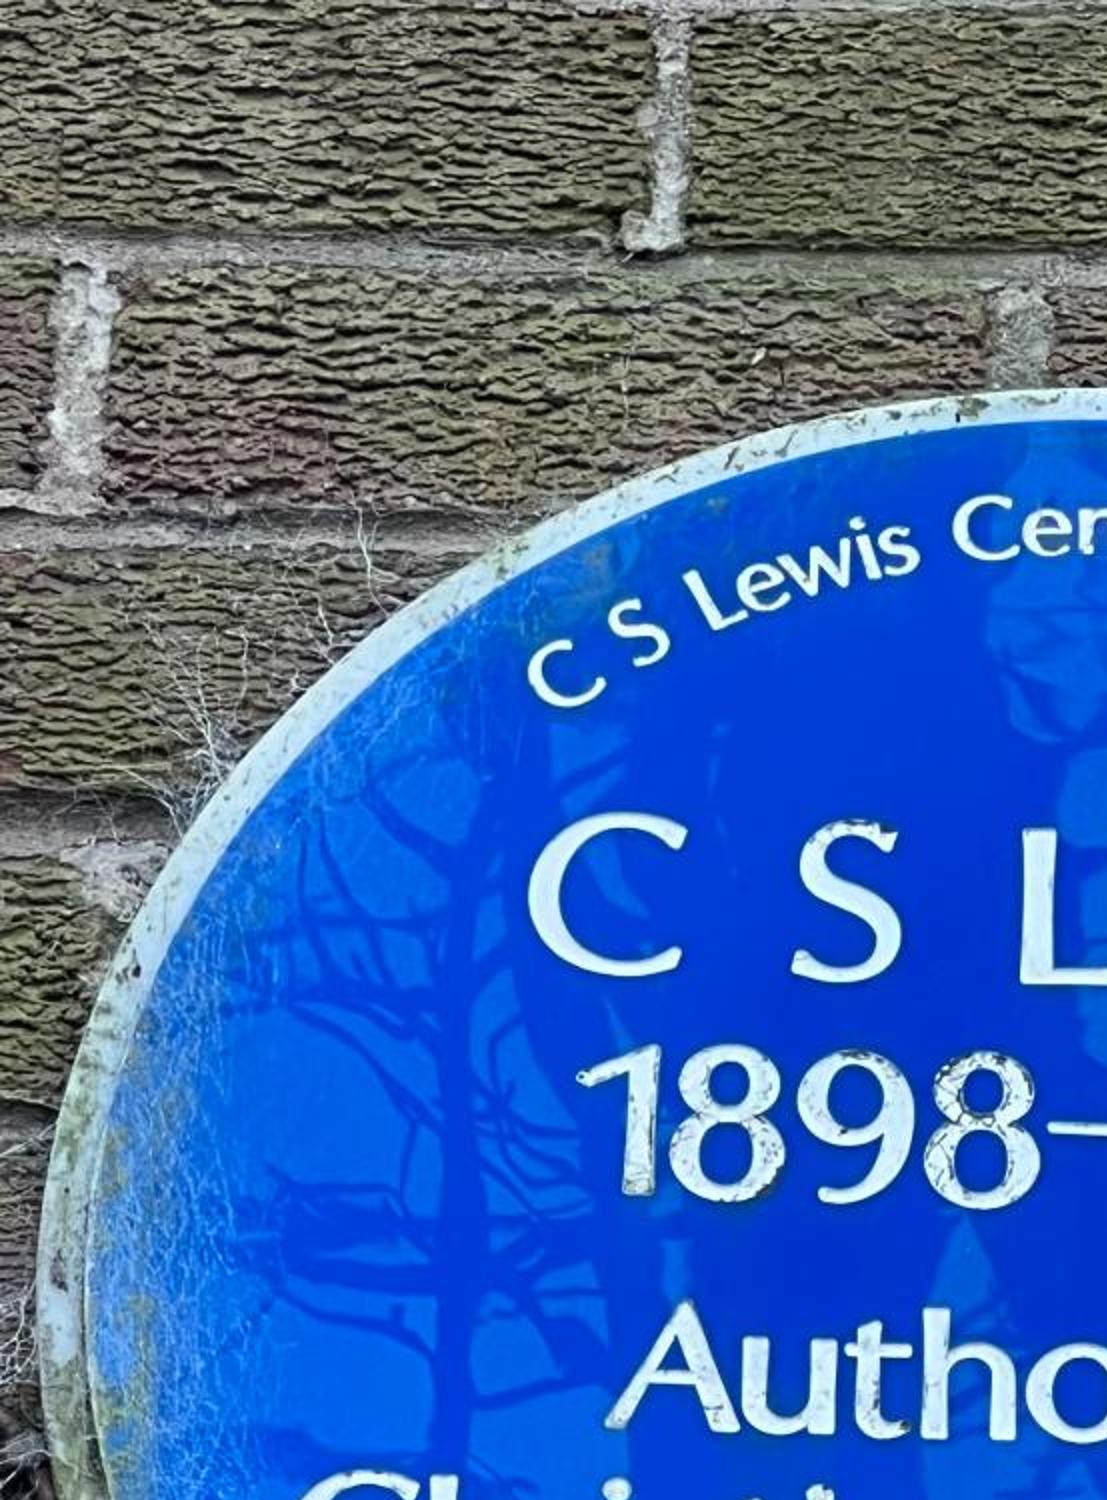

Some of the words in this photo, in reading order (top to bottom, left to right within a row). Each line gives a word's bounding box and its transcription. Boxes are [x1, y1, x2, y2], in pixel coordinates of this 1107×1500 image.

[528, 640, 605, 708] C
[607, 598, 670, 667] S
[683, 516, 922, 632] Lewis
[528, 813, 687, 977] C
[791, 822, 901, 983] S
